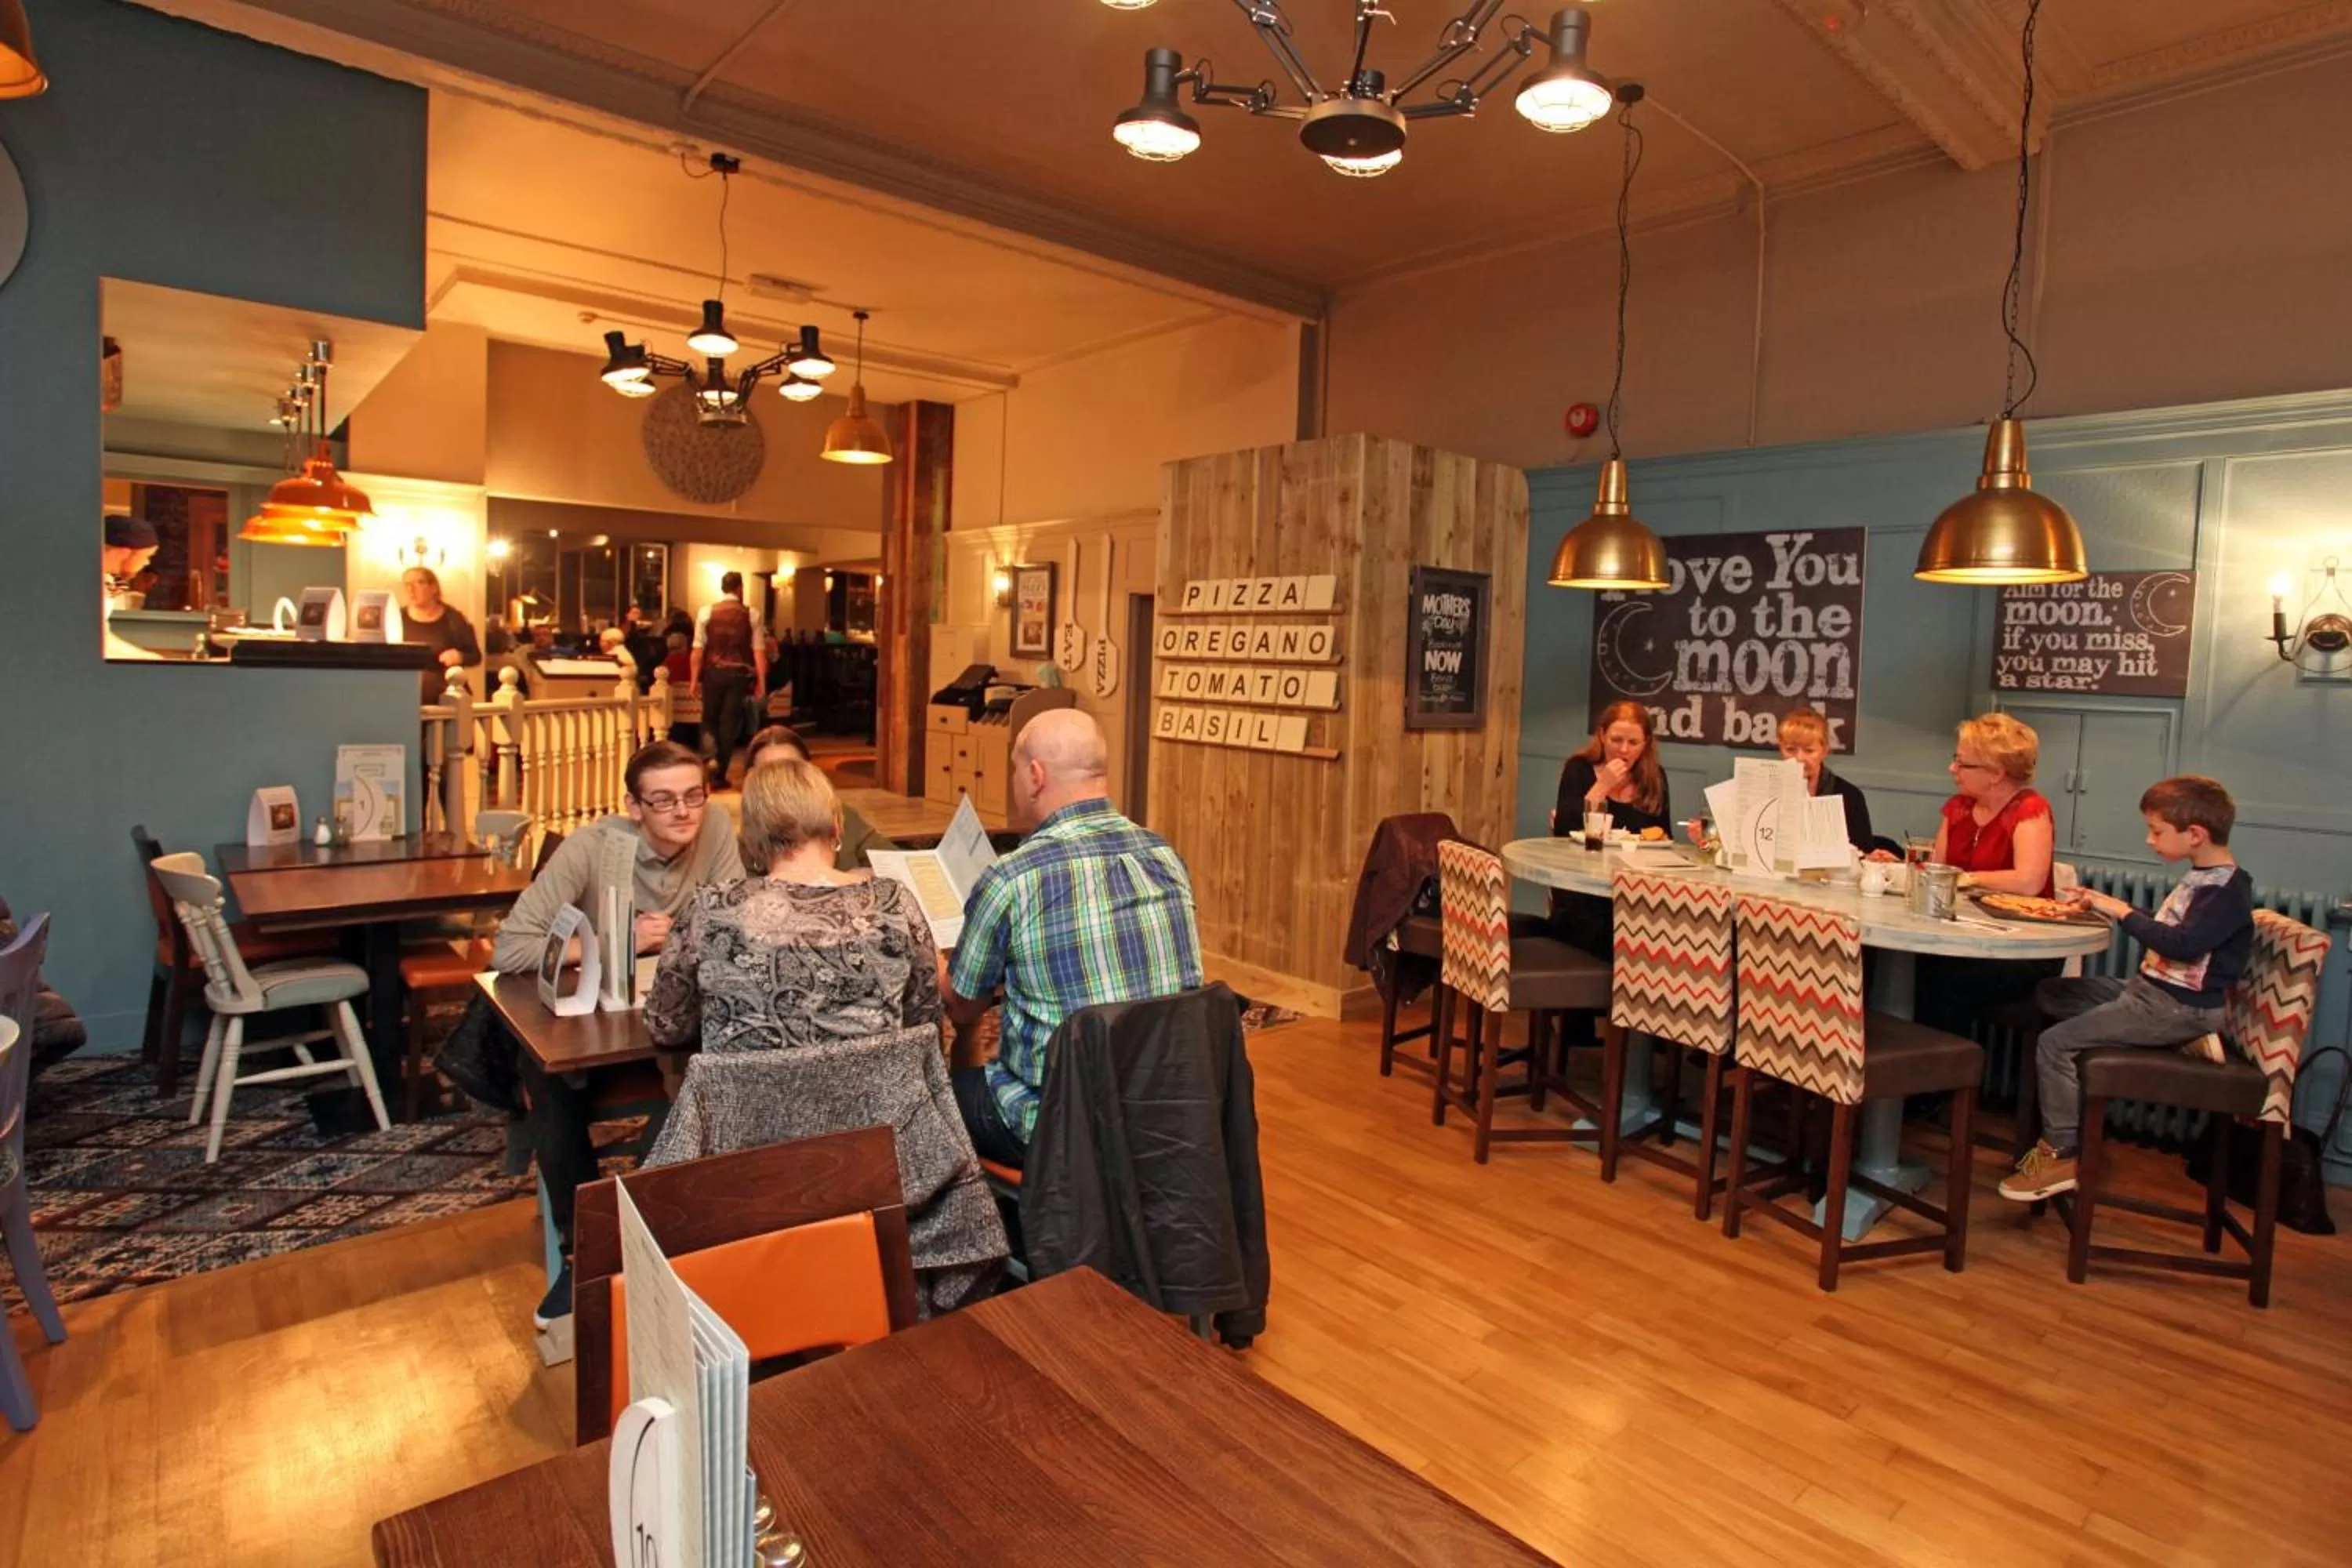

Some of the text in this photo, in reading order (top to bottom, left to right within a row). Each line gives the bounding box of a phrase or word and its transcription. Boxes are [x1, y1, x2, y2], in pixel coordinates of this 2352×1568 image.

[1635, 533, 1861, 595] ove You
[1186, 583, 1298, 606] PIZZA
[2051, 583, 2084, 598] for
[2088, 575, 2123, 598] the
[1689, 592, 1852, 639] to the
[1163, 631, 1327, 654] OREGANO
[2002, 626, 2155, 655] if you miss,
[1097, 639, 1106, 694] PIZZA
[1425, 650, 1463, 674] NOW
[1673, 639, 1854, 699] moon
[1997, 652, 2158, 680] you may hit
[1167, 671, 1301, 699] TOMATO
[2000, 673, 2099, 690] a star.
[1160, 712, 1270, 742] BASIL
[1645, 695, 1846, 750] nd bak
[1759, 827, 1773, 840] 12
